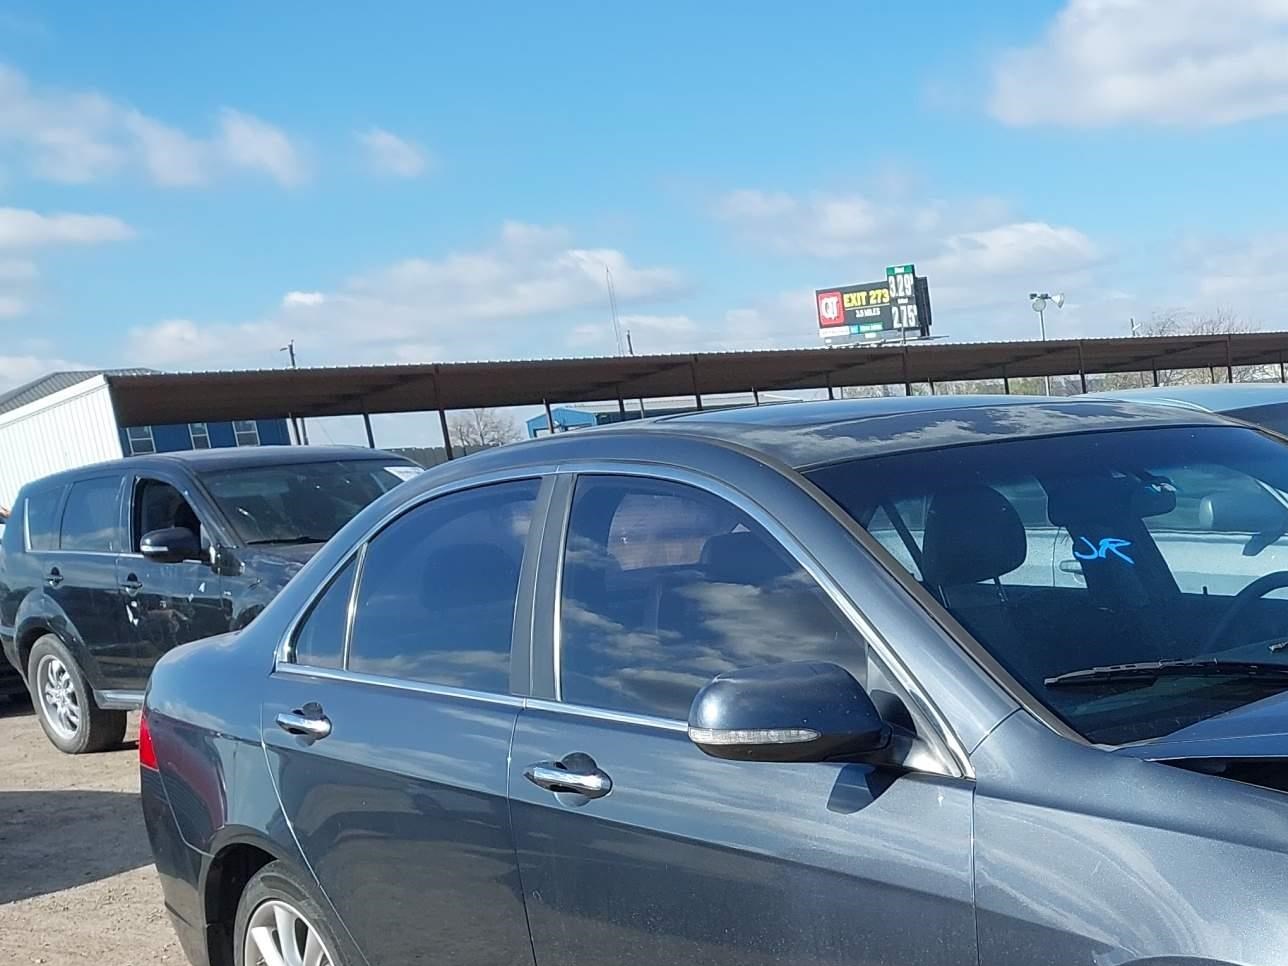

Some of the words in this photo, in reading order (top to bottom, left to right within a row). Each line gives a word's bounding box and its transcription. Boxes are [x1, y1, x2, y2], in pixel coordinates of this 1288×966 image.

[843, 291, 868, 308] EXIT
[869, 288, 890, 304] 273
[821, 297, 839, 320] QT
[864, 307, 881, 317] MILES
